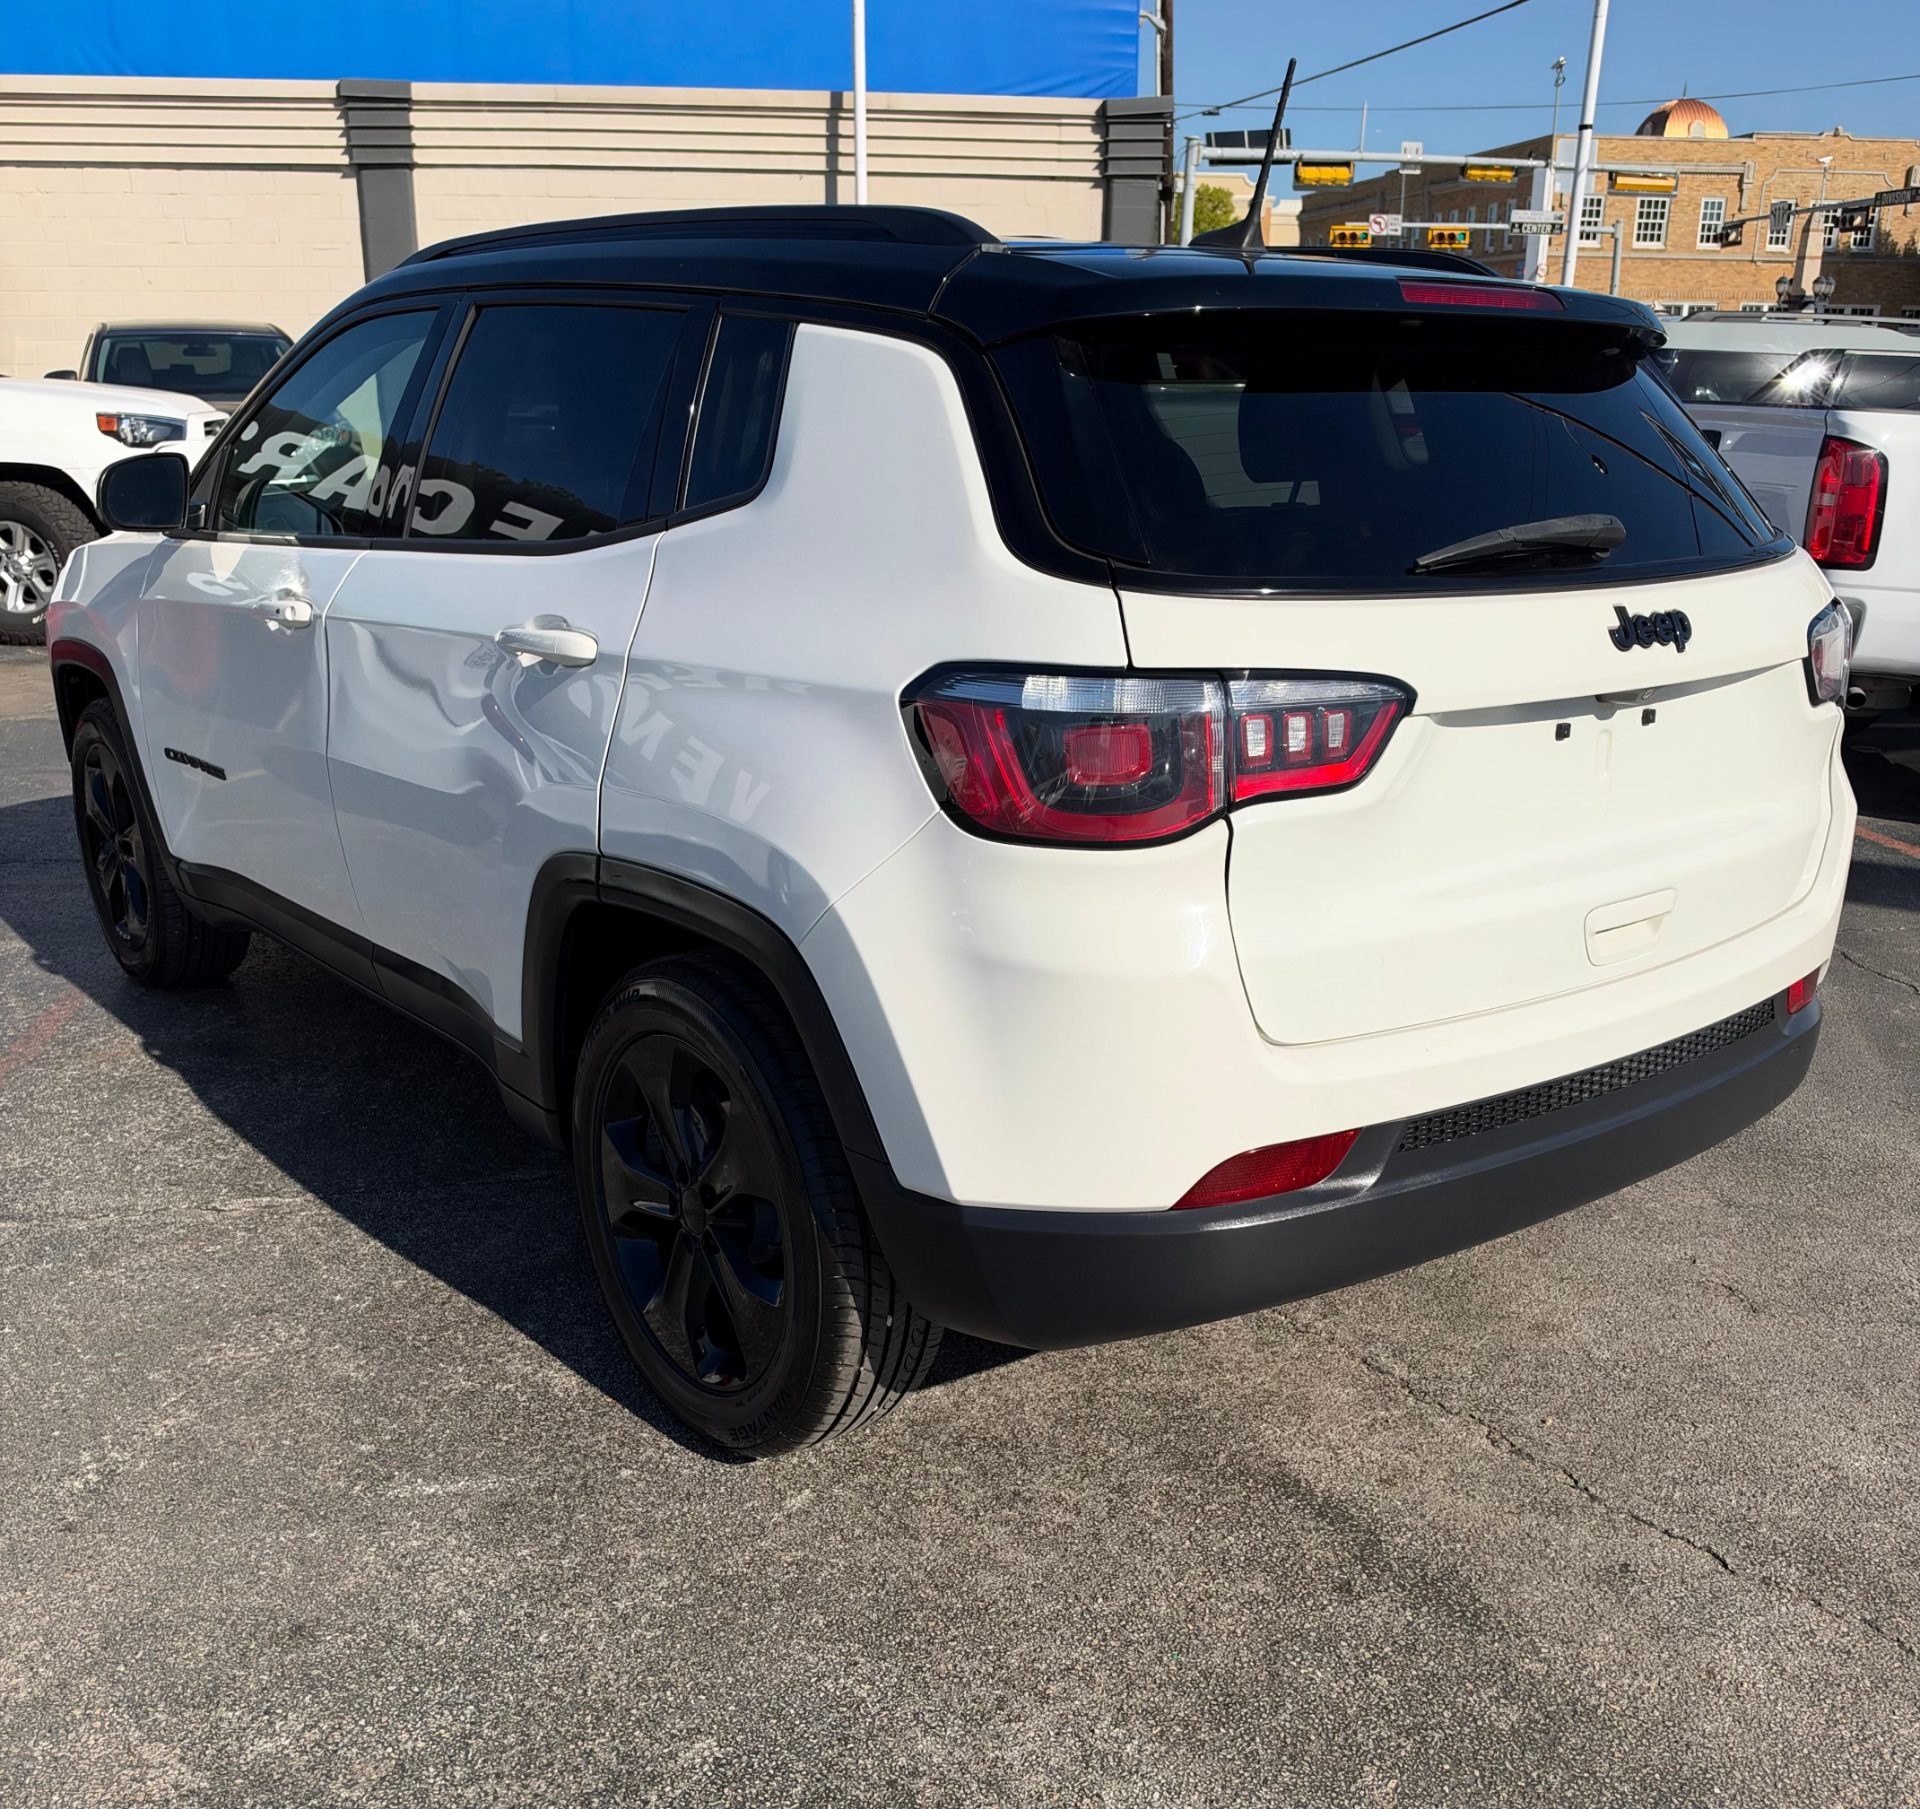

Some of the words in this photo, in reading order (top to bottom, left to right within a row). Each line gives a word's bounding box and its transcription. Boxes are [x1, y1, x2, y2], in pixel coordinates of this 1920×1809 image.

[1521, 223, 1553, 234] CENTER
[1608, 603, 1692, 653] Jeep
[727, 1386, 791, 1442] VANTAGE
